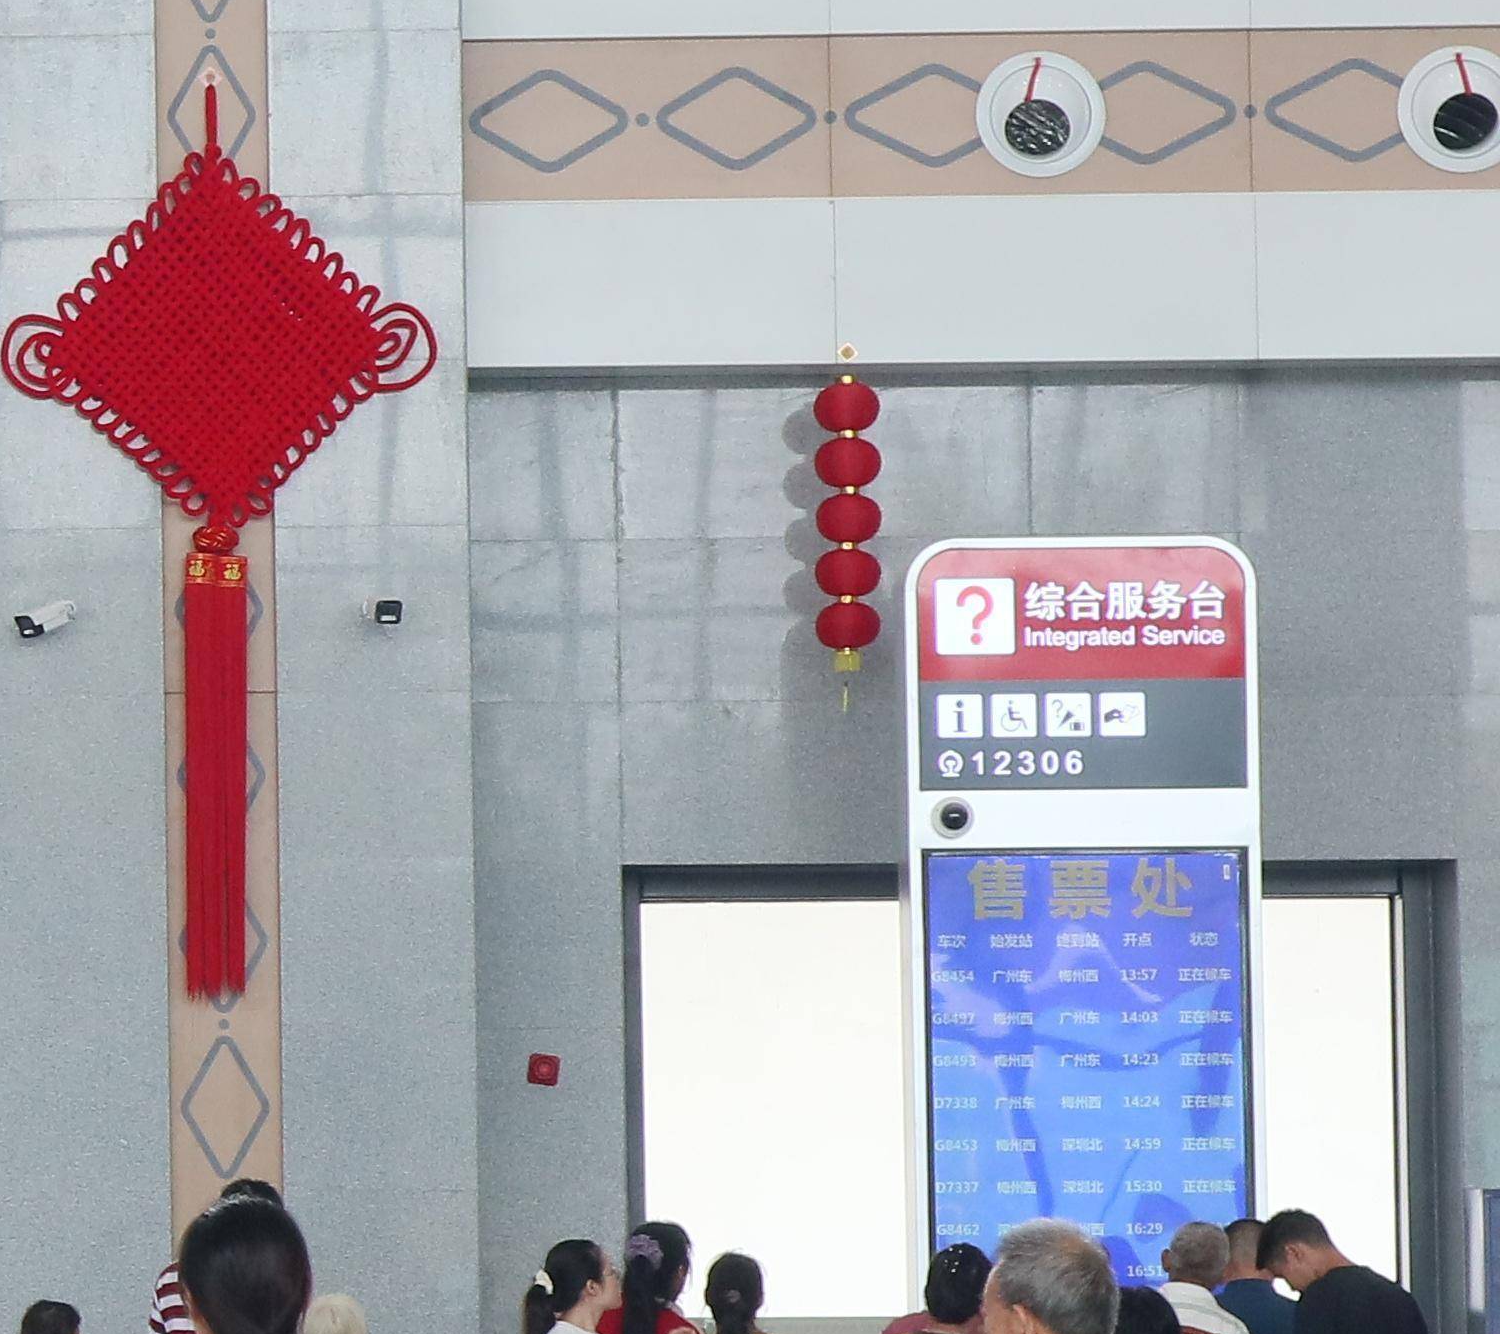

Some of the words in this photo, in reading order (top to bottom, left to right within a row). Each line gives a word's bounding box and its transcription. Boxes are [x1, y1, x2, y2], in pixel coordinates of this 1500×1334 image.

[1025, 580, 1224, 620] 综合服务台
[1026, 626, 1135, 650] Integrated
[1143, 626, 1224, 645] Service
[973, 751, 1082, 774] 12306
[968, 859, 1193, 920] 售票处
[937, 935, 966, 948] 车次
[990, 934, 1033, 949] 始发站
[1056, 933, 1099, 948] 终到站
[1123, 933, 1152, 947] 开点
[1190, 932, 1219, 947] 状态
[993, 970, 1032, 984] 广州东
[1120, 969, 1157, 981] 13:57
[1178, 968, 1231, 982] 正在候车
[1060, 1011, 1099, 1025] 广州东
[1121, 1011, 1158, 1023] 14:03
[1179, 1010, 1233, 1024] 正在候车
[1061, 1054, 1100, 1067] 广州东
[1122, 1053, 1159, 1066] 14:23
[1180, 1052, 1233, 1066] 正在候车
[995, 1096, 1035, 1110] 广州东
[1124, 1095, 1161, 1108] 14:24
[1181, 1095, 1234, 1108] 正在候车
[1124, 1138, 1161, 1150] 14:59
[1182, 1137, 1236, 1151] 正在候车
[1125, 1180, 1162, 1192] 15:30
[1182, 1179, 1236, 1194] 正在候车
[1126, 1223, 1163, 1235] 16:29
